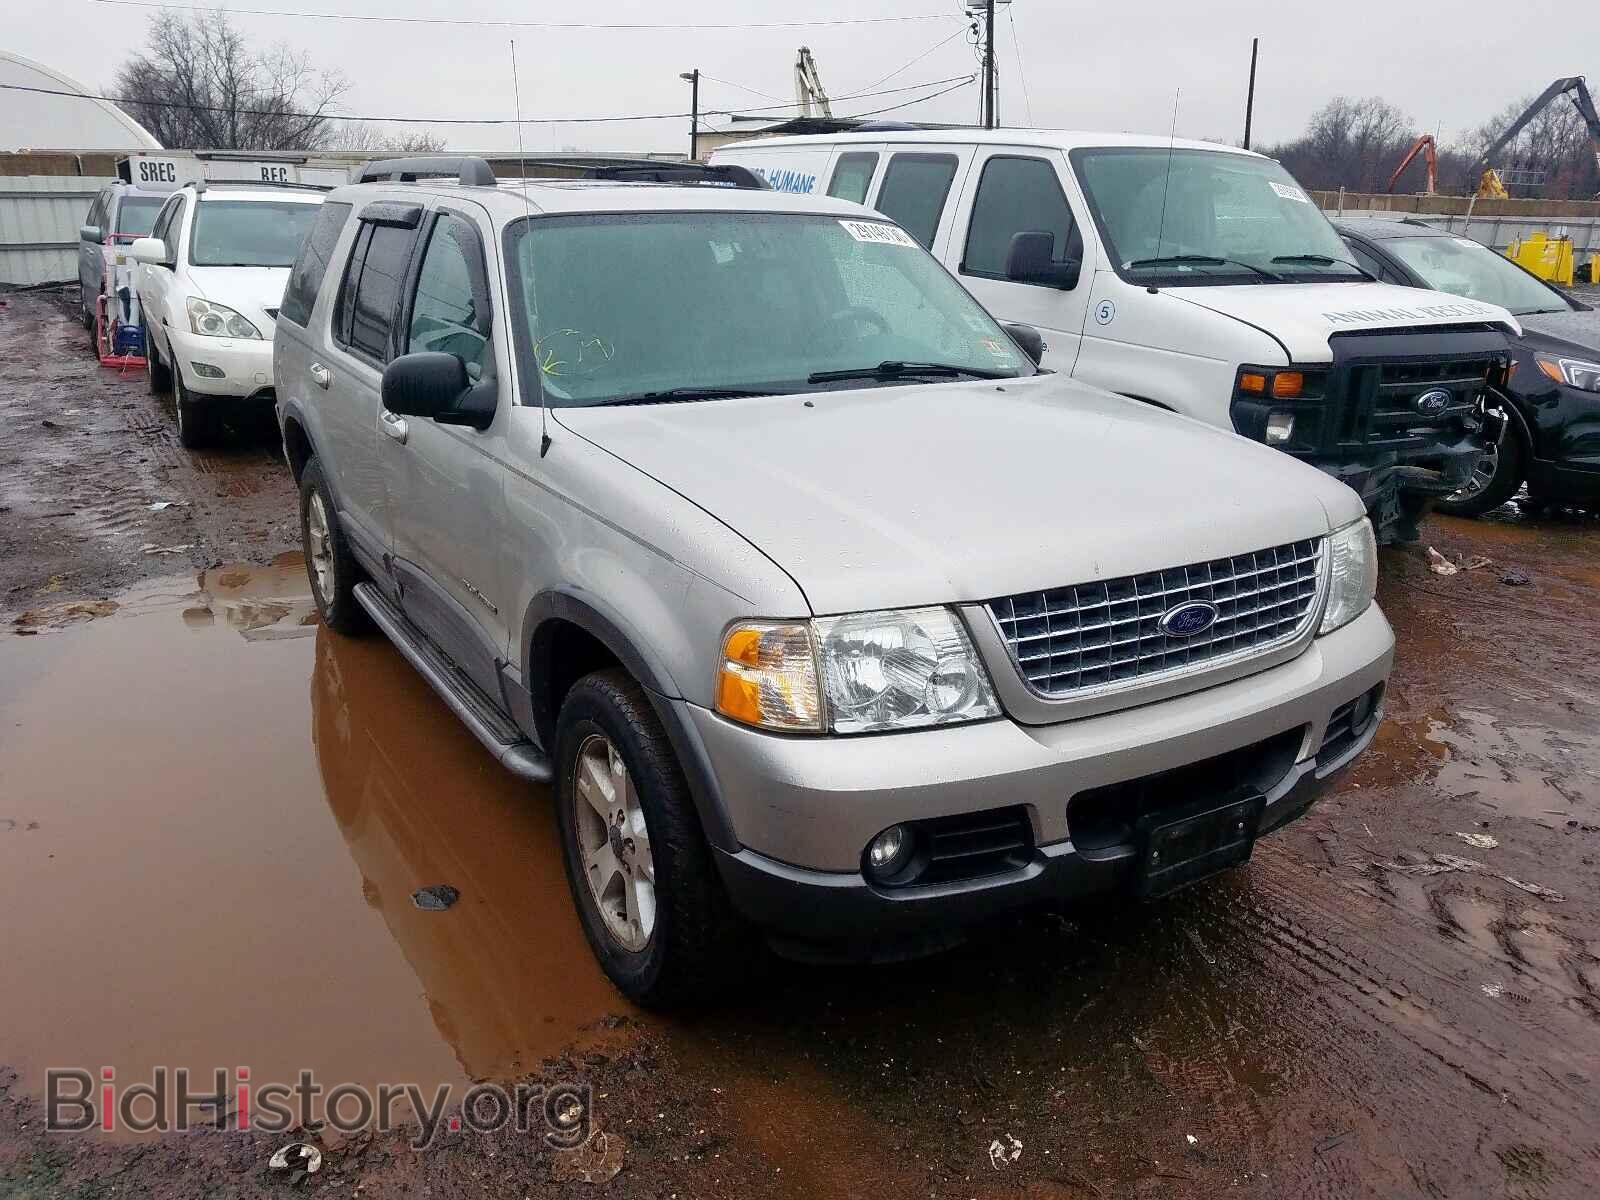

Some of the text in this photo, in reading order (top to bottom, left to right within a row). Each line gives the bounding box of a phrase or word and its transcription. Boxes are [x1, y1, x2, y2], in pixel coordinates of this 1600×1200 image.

[139, 161, 176, 183] SREC
[1100, 306, 1109, 319] 5
[1322, 303, 1491, 323] ANIMAL RESCUE
[1175, 610, 1205, 628] Ford
